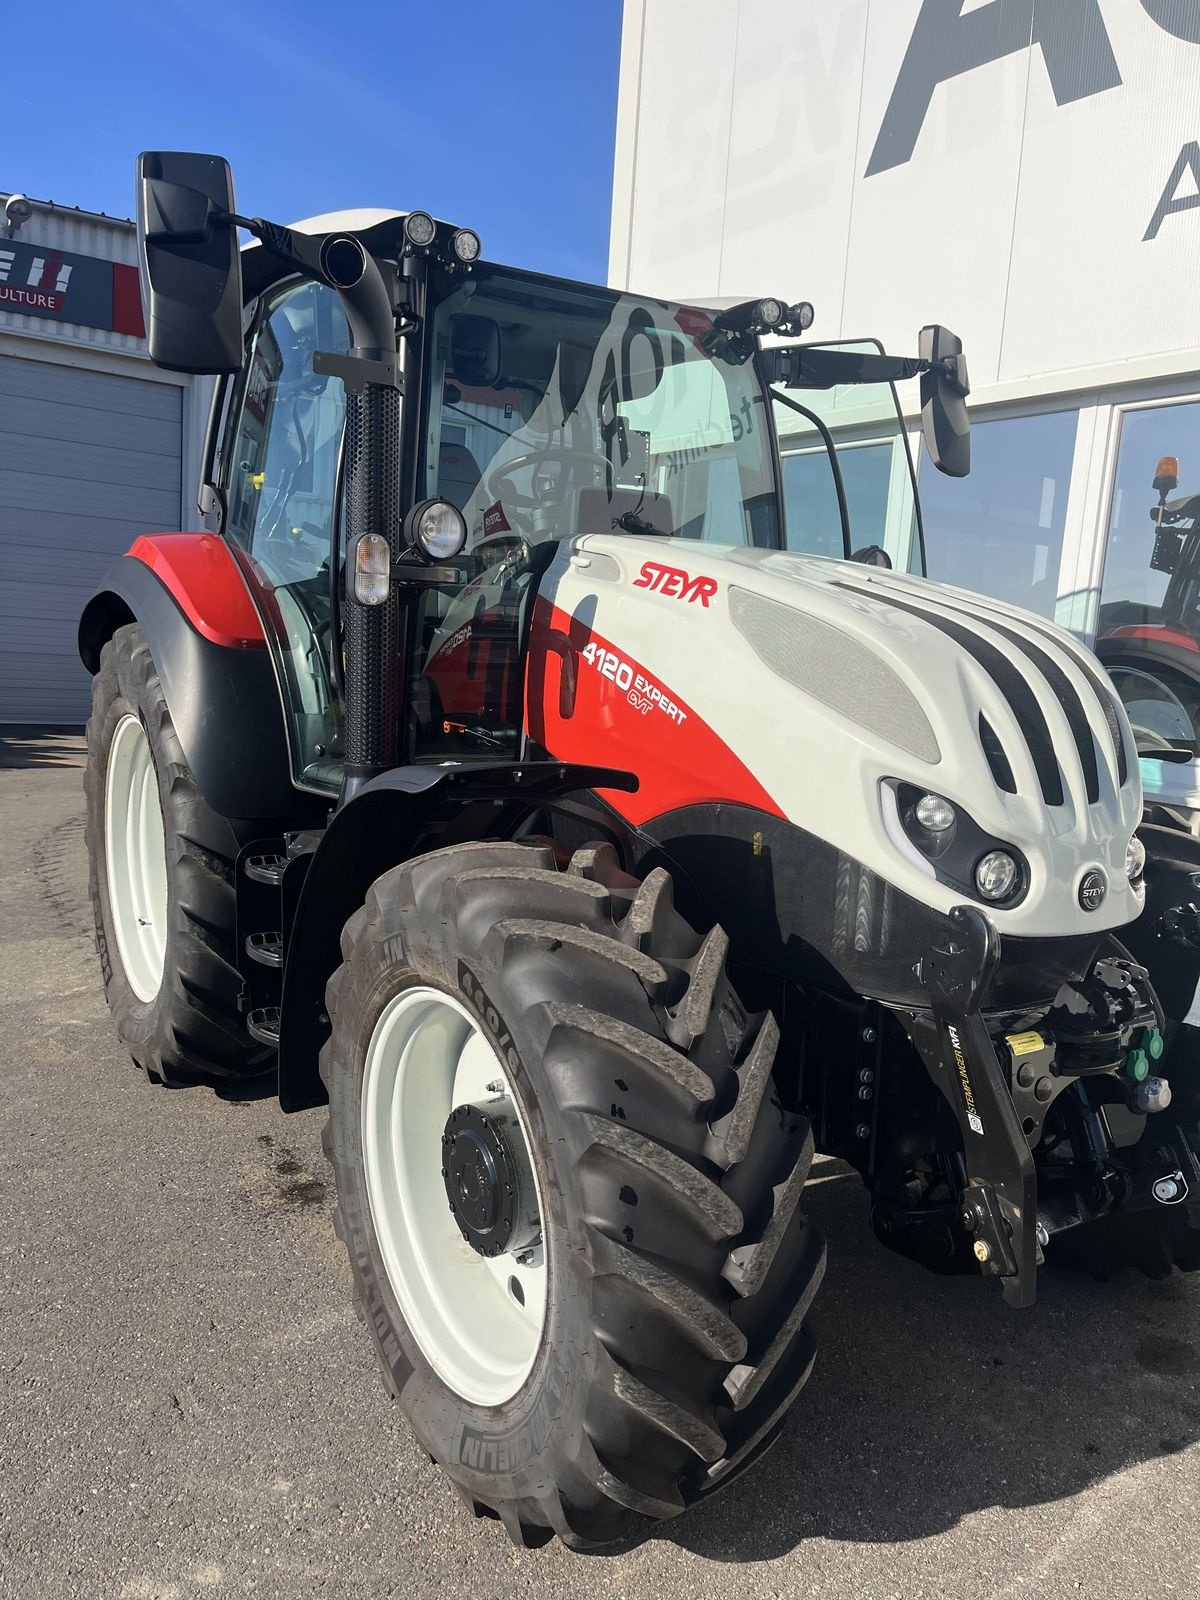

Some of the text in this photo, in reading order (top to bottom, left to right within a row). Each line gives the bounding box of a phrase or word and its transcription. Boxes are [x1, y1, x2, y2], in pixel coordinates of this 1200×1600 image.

[632, 561, 719, 608] STEYR
[583, 642, 687, 725] 4120 EXPERT
[626, 690, 653, 714] CVT
[1082, 886, 1105, 898] STEYR
[954, 1050, 977, 1115] STEMPLINGER
